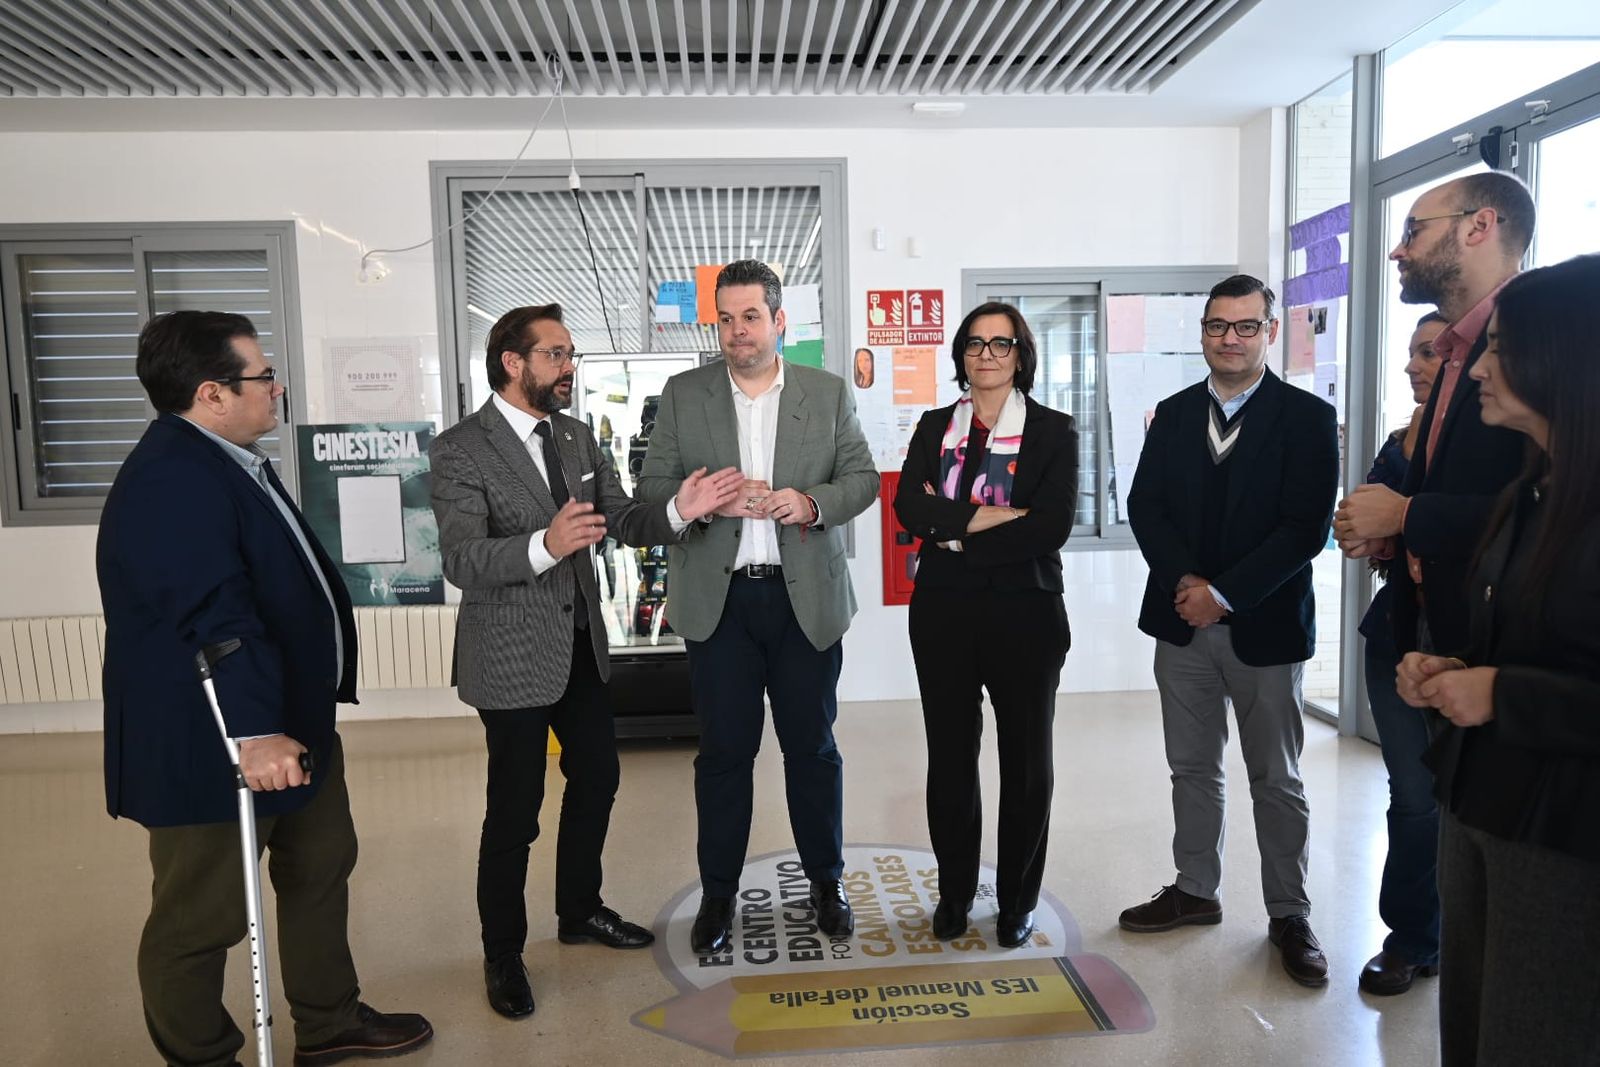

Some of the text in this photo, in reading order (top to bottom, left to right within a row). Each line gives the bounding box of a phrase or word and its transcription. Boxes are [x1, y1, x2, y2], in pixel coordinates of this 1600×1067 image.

[878, 337, 903, 345] ALARMA
[908, 332, 943, 342] EXTINTOR
[347, 372, 363, 380] 900
[365, 372, 381, 380] 200
[312, 430, 421, 462] CINESTESIA
[329, 463, 366, 472] cineforum
[390, 586, 431, 594] Maracena
[775, 860, 825, 963] EDUCATIVO
[844, 870, 896, 957] CAMINOS
[873, 855, 943, 955] ESCOLARES
[740, 888, 779, 965] CENTRO
[829, 936, 853, 960] FOR
[769, 977, 1040, 1008] IES Manuel deFalla
[851, 1002, 972, 1024] Sección
